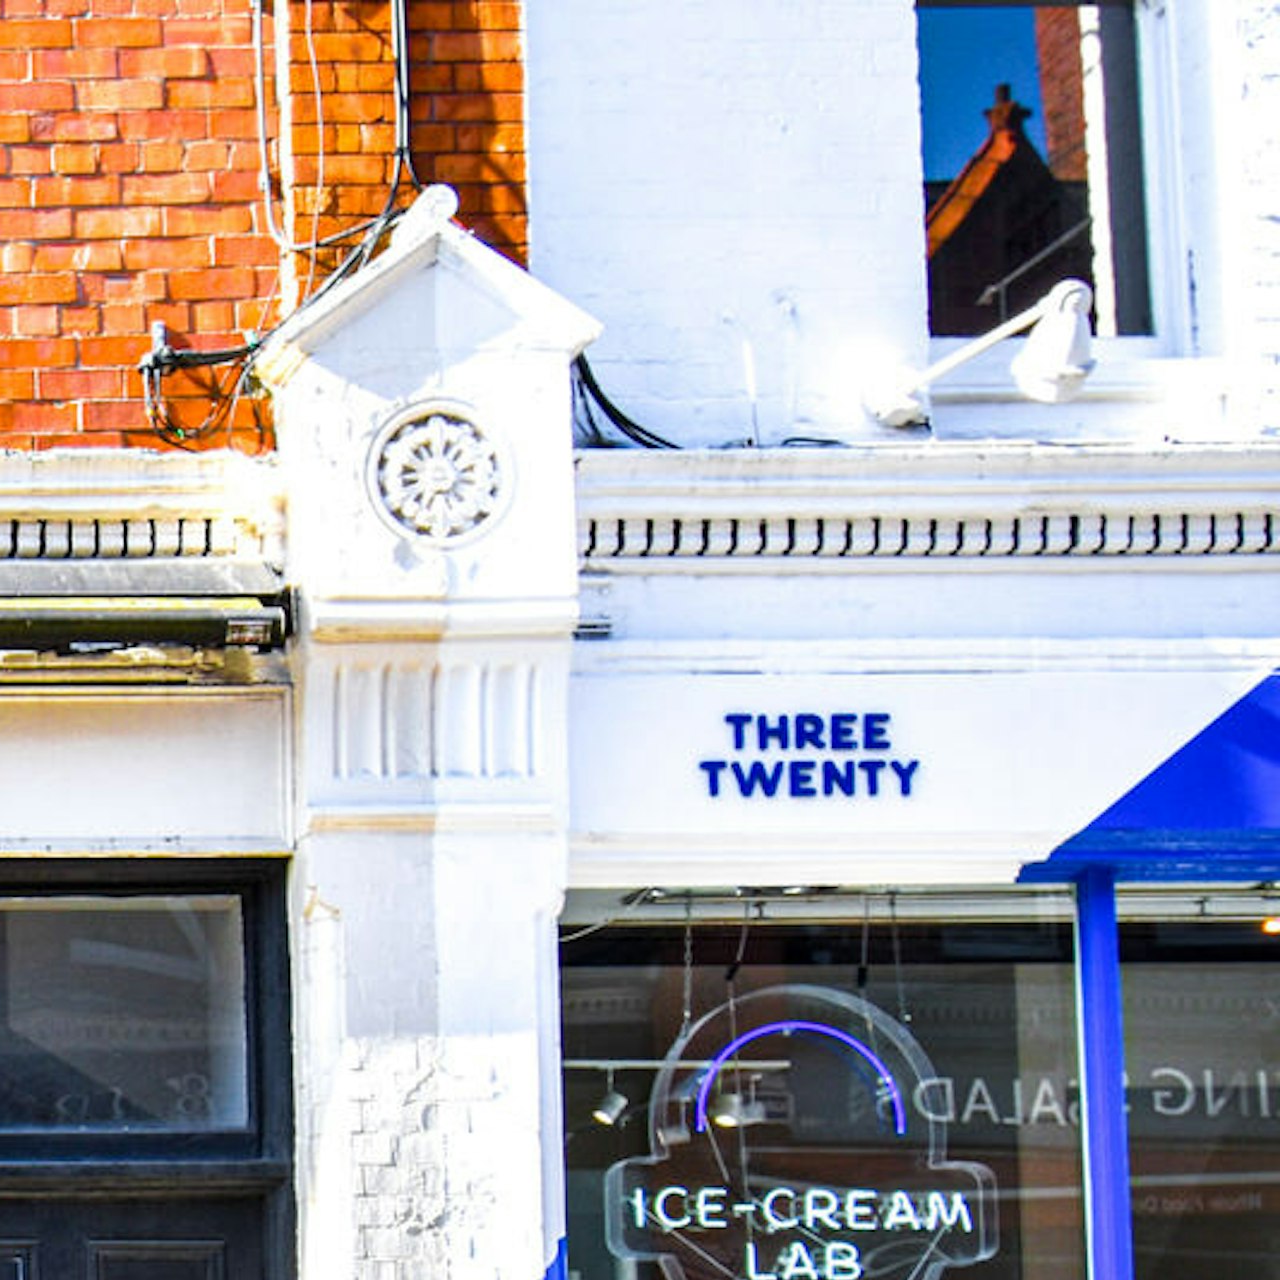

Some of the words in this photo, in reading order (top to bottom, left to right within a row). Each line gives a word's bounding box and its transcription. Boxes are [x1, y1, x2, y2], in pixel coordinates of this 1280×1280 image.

[726, 713, 891, 750] THREE
[699, 759, 920, 798] TWENTY
[632, 1186, 973, 1234] ICE-CREAM
